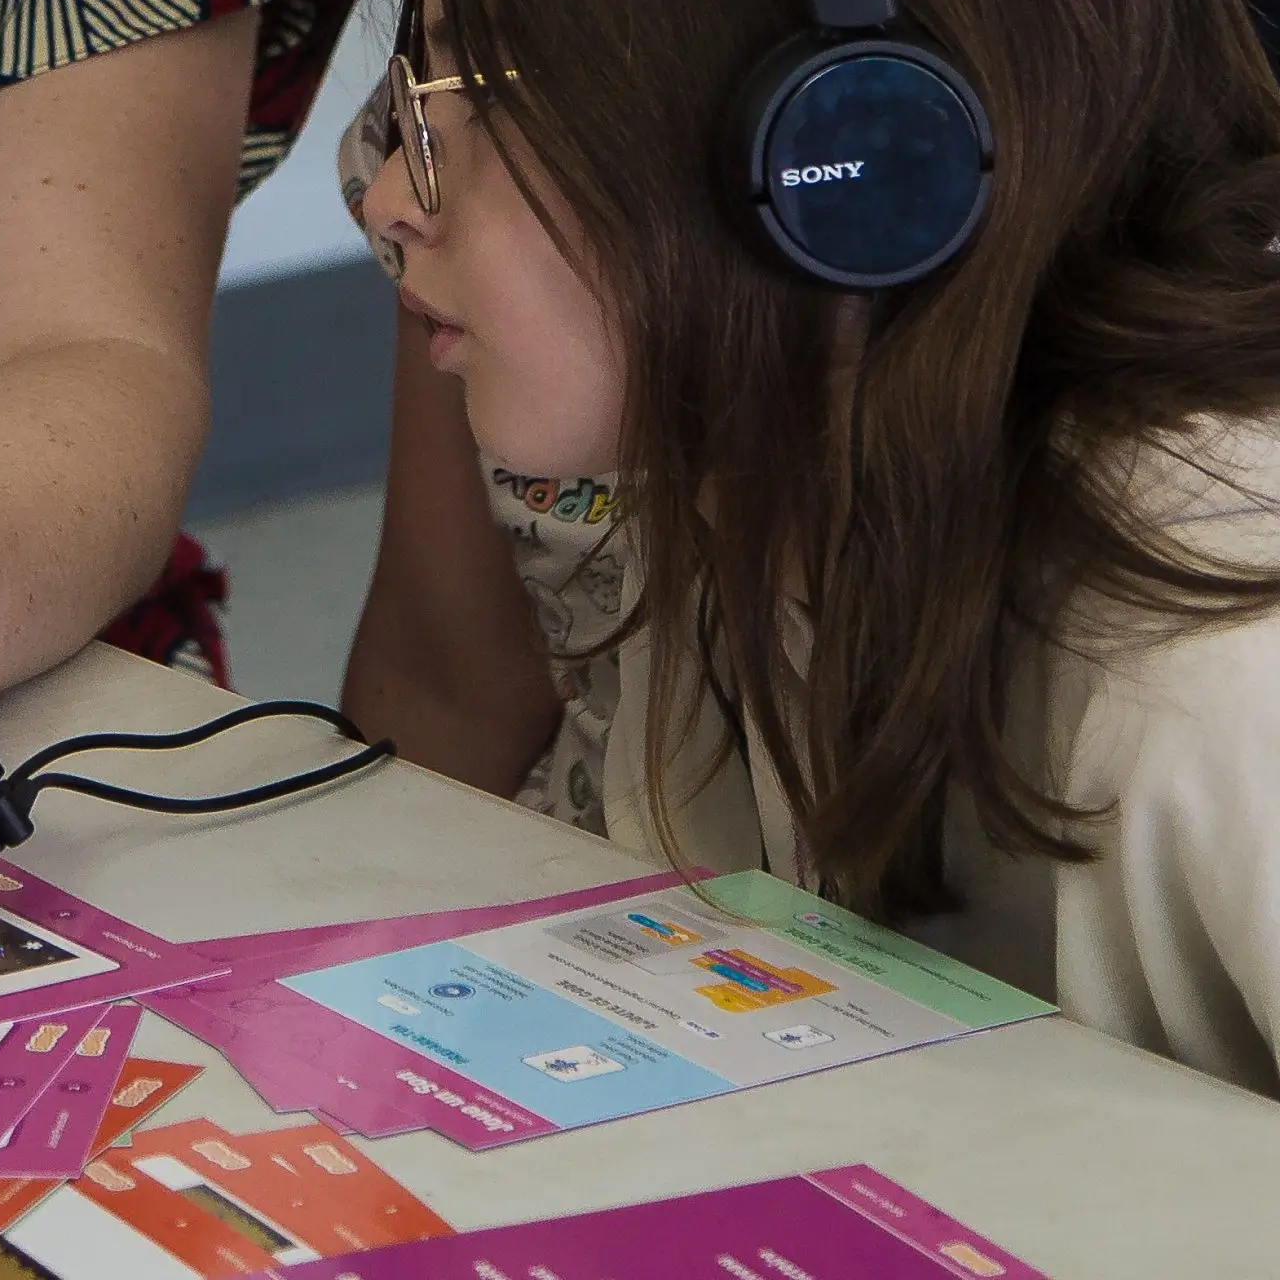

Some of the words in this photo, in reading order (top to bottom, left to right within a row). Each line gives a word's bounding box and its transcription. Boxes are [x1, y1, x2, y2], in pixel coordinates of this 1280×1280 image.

[781, 161, 864, 188] SONY
[395, 1069, 440, 1094] Son
[433, 1090, 466, 1107] un
[461, 1105, 515, 1132] Joue
